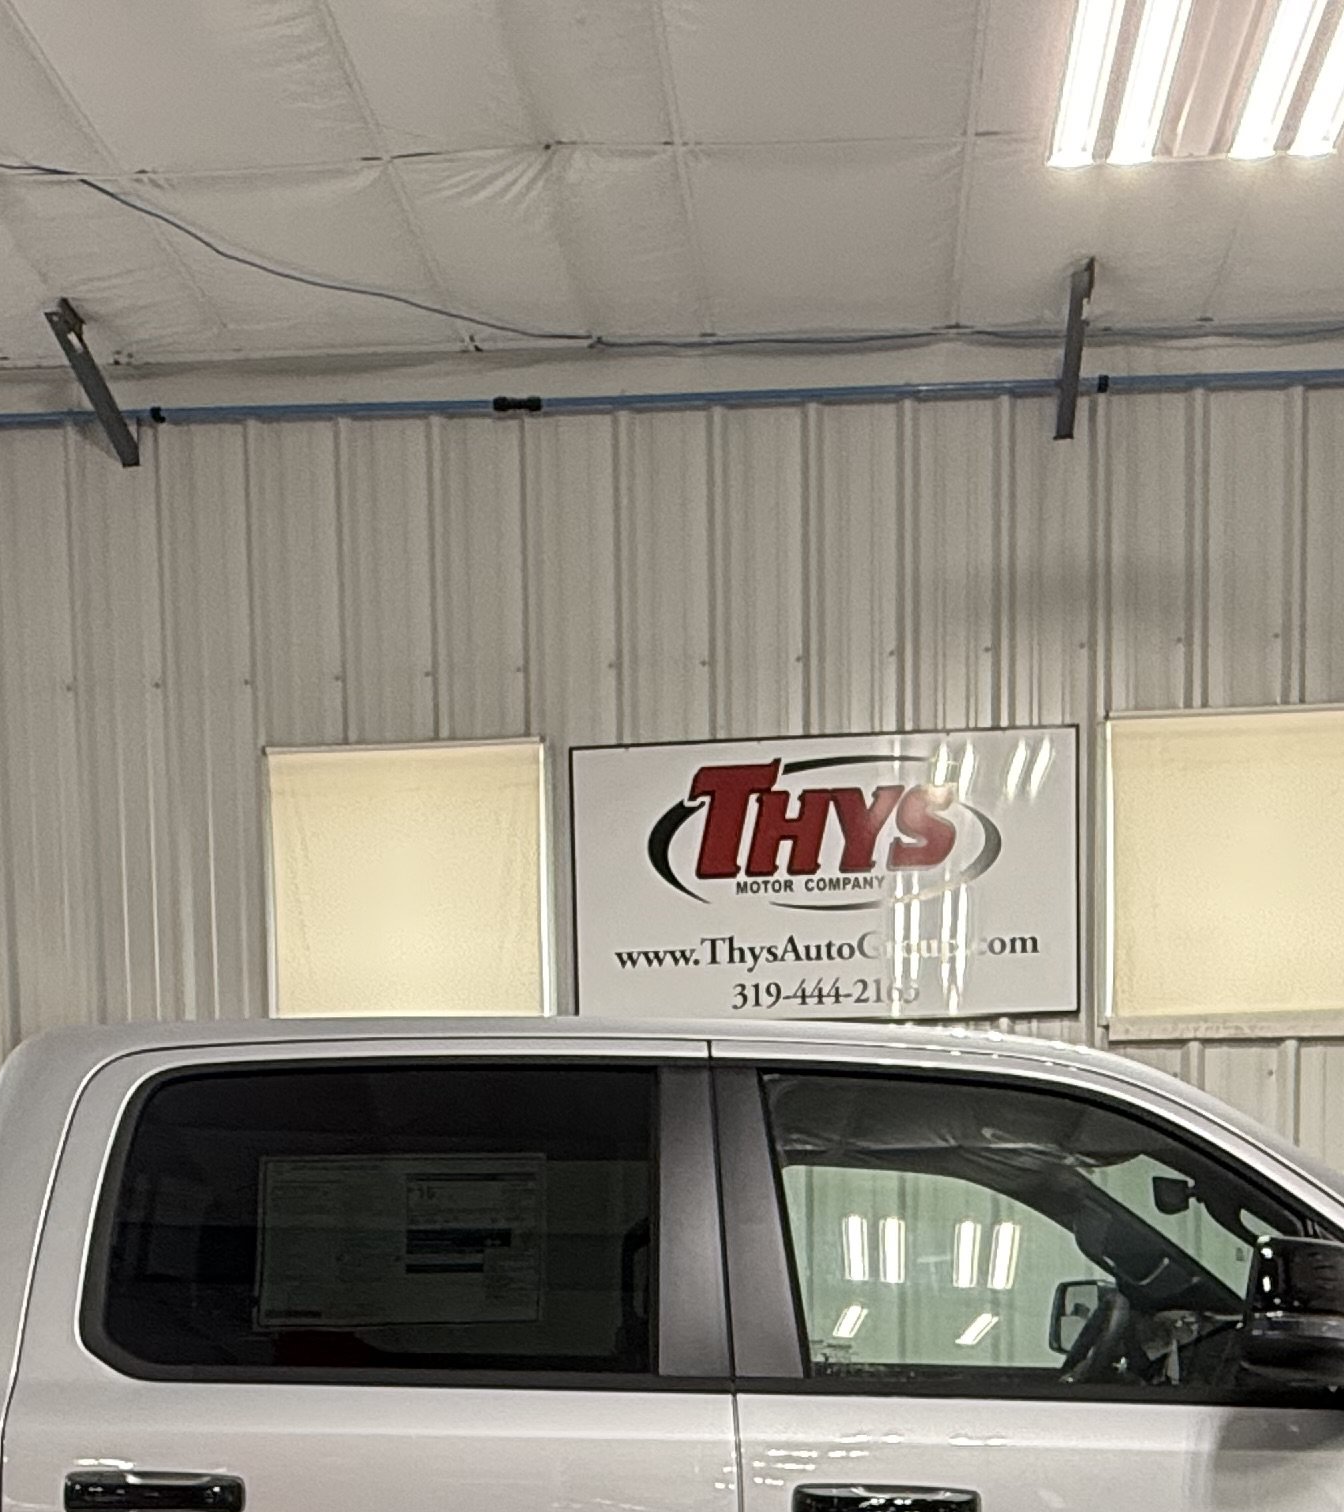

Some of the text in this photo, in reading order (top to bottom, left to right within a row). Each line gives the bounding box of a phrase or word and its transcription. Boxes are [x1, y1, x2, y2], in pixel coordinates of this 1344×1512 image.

[689, 758, 956, 879] THYS
[736, 876, 885, 895] MOTOR COMPANY
[614, 933, 1040, 972] www.ThysAutoGoupcom
